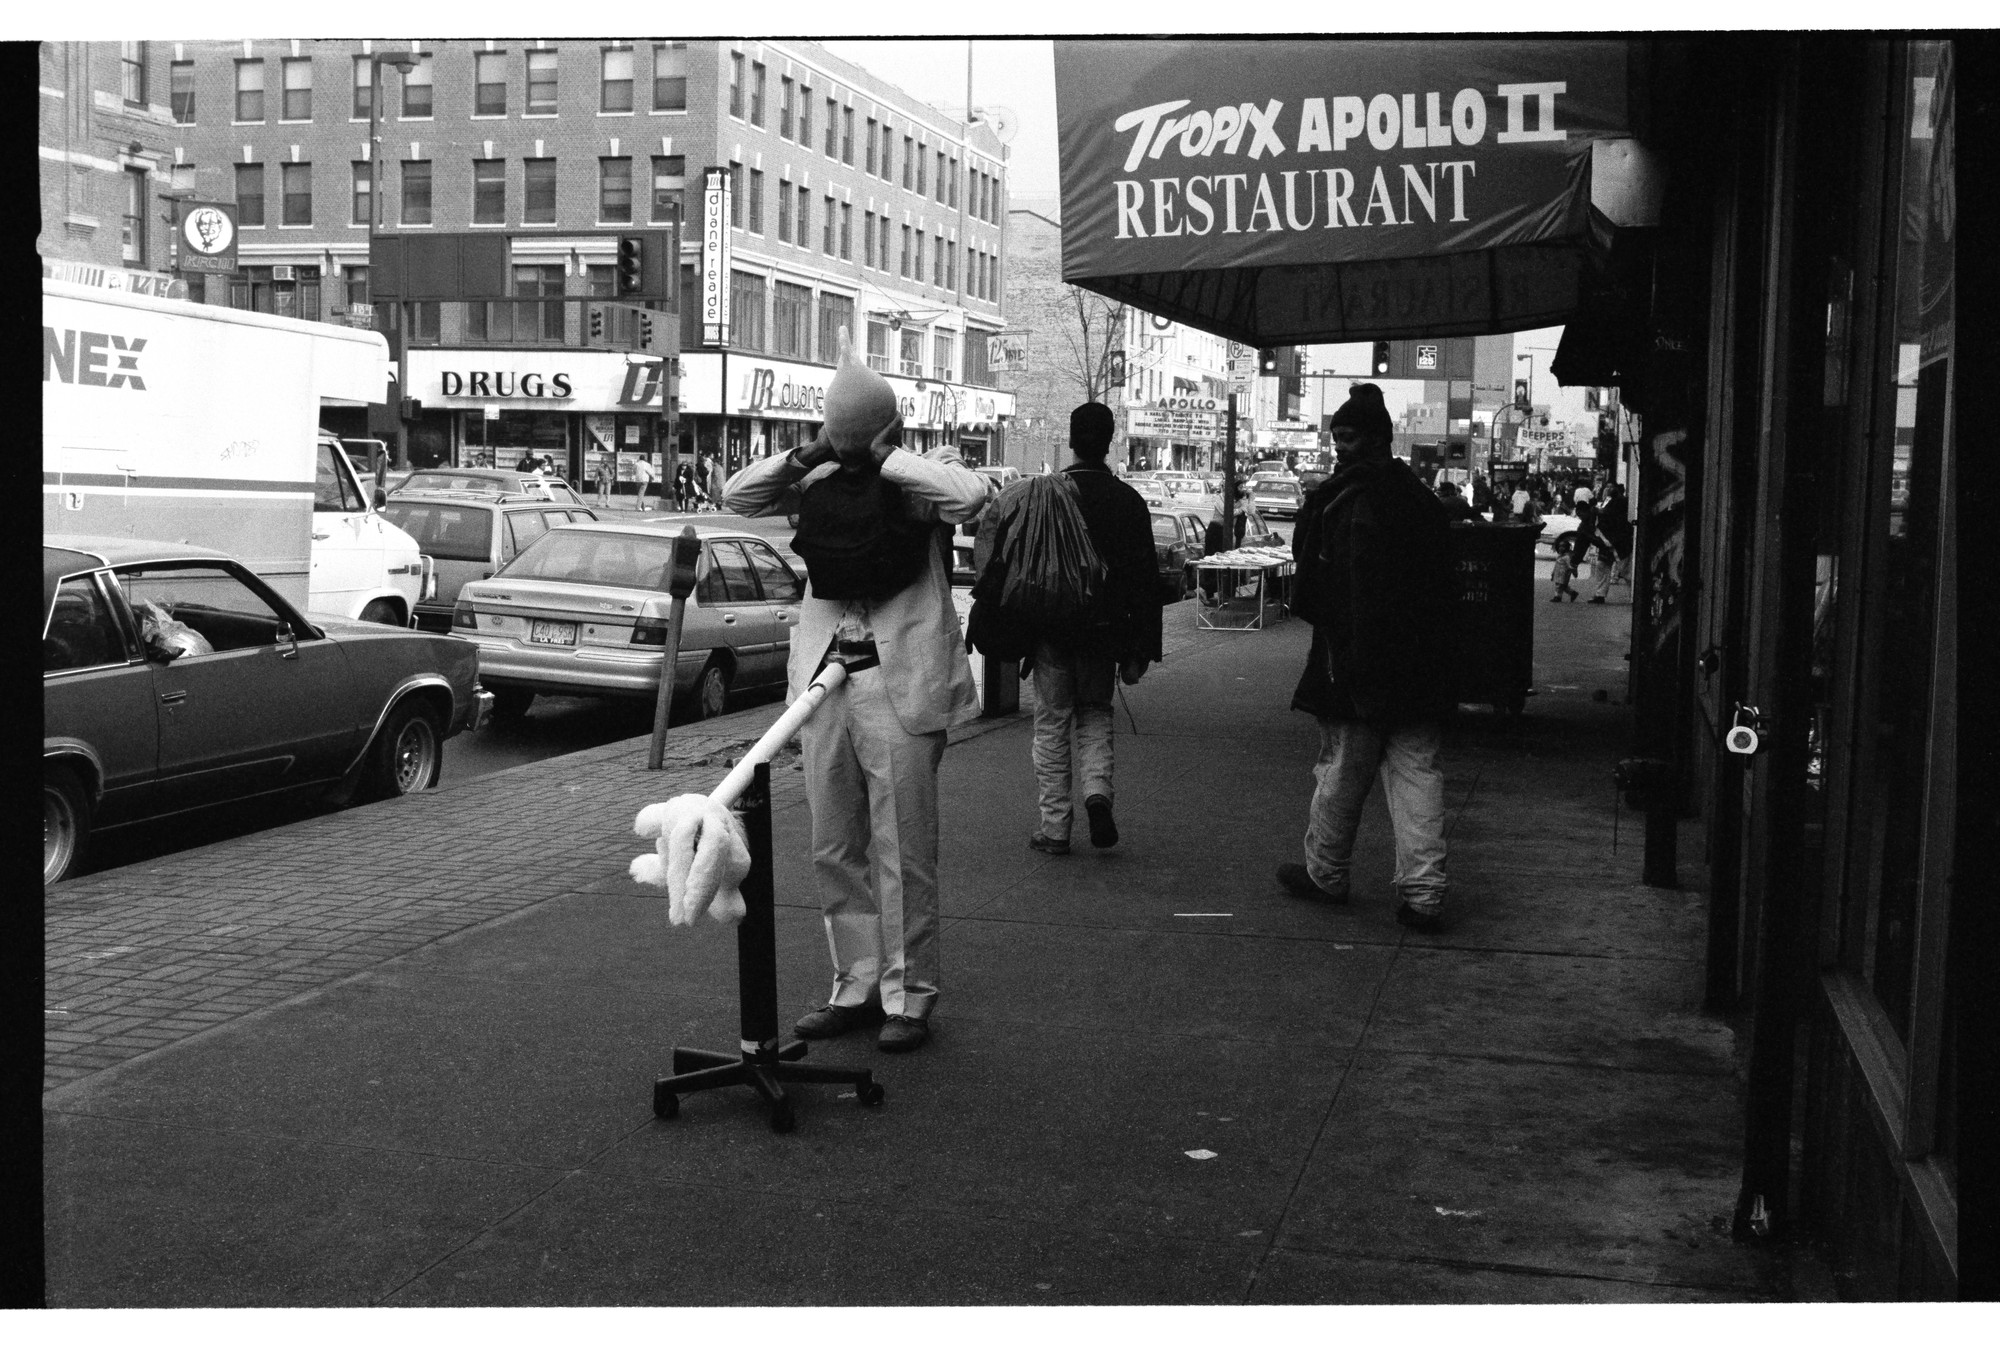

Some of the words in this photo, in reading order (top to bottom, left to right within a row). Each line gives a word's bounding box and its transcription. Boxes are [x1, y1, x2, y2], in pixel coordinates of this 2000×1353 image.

[1297, 87, 1487, 154] APOLLO
[1496, 81, 1568, 144] II
[708, 192, 719, 252] duane
[1113, 160, 1476, 240] RESTAURANT
[707, 258, 718, 319] reade
[441, 371, 574, 398] DRUGS
[782, 374, 824, 410] duane
[1158, 397, 1216, 411] APOLLO
[1522, 429, 1565, 441] BEEPERS
